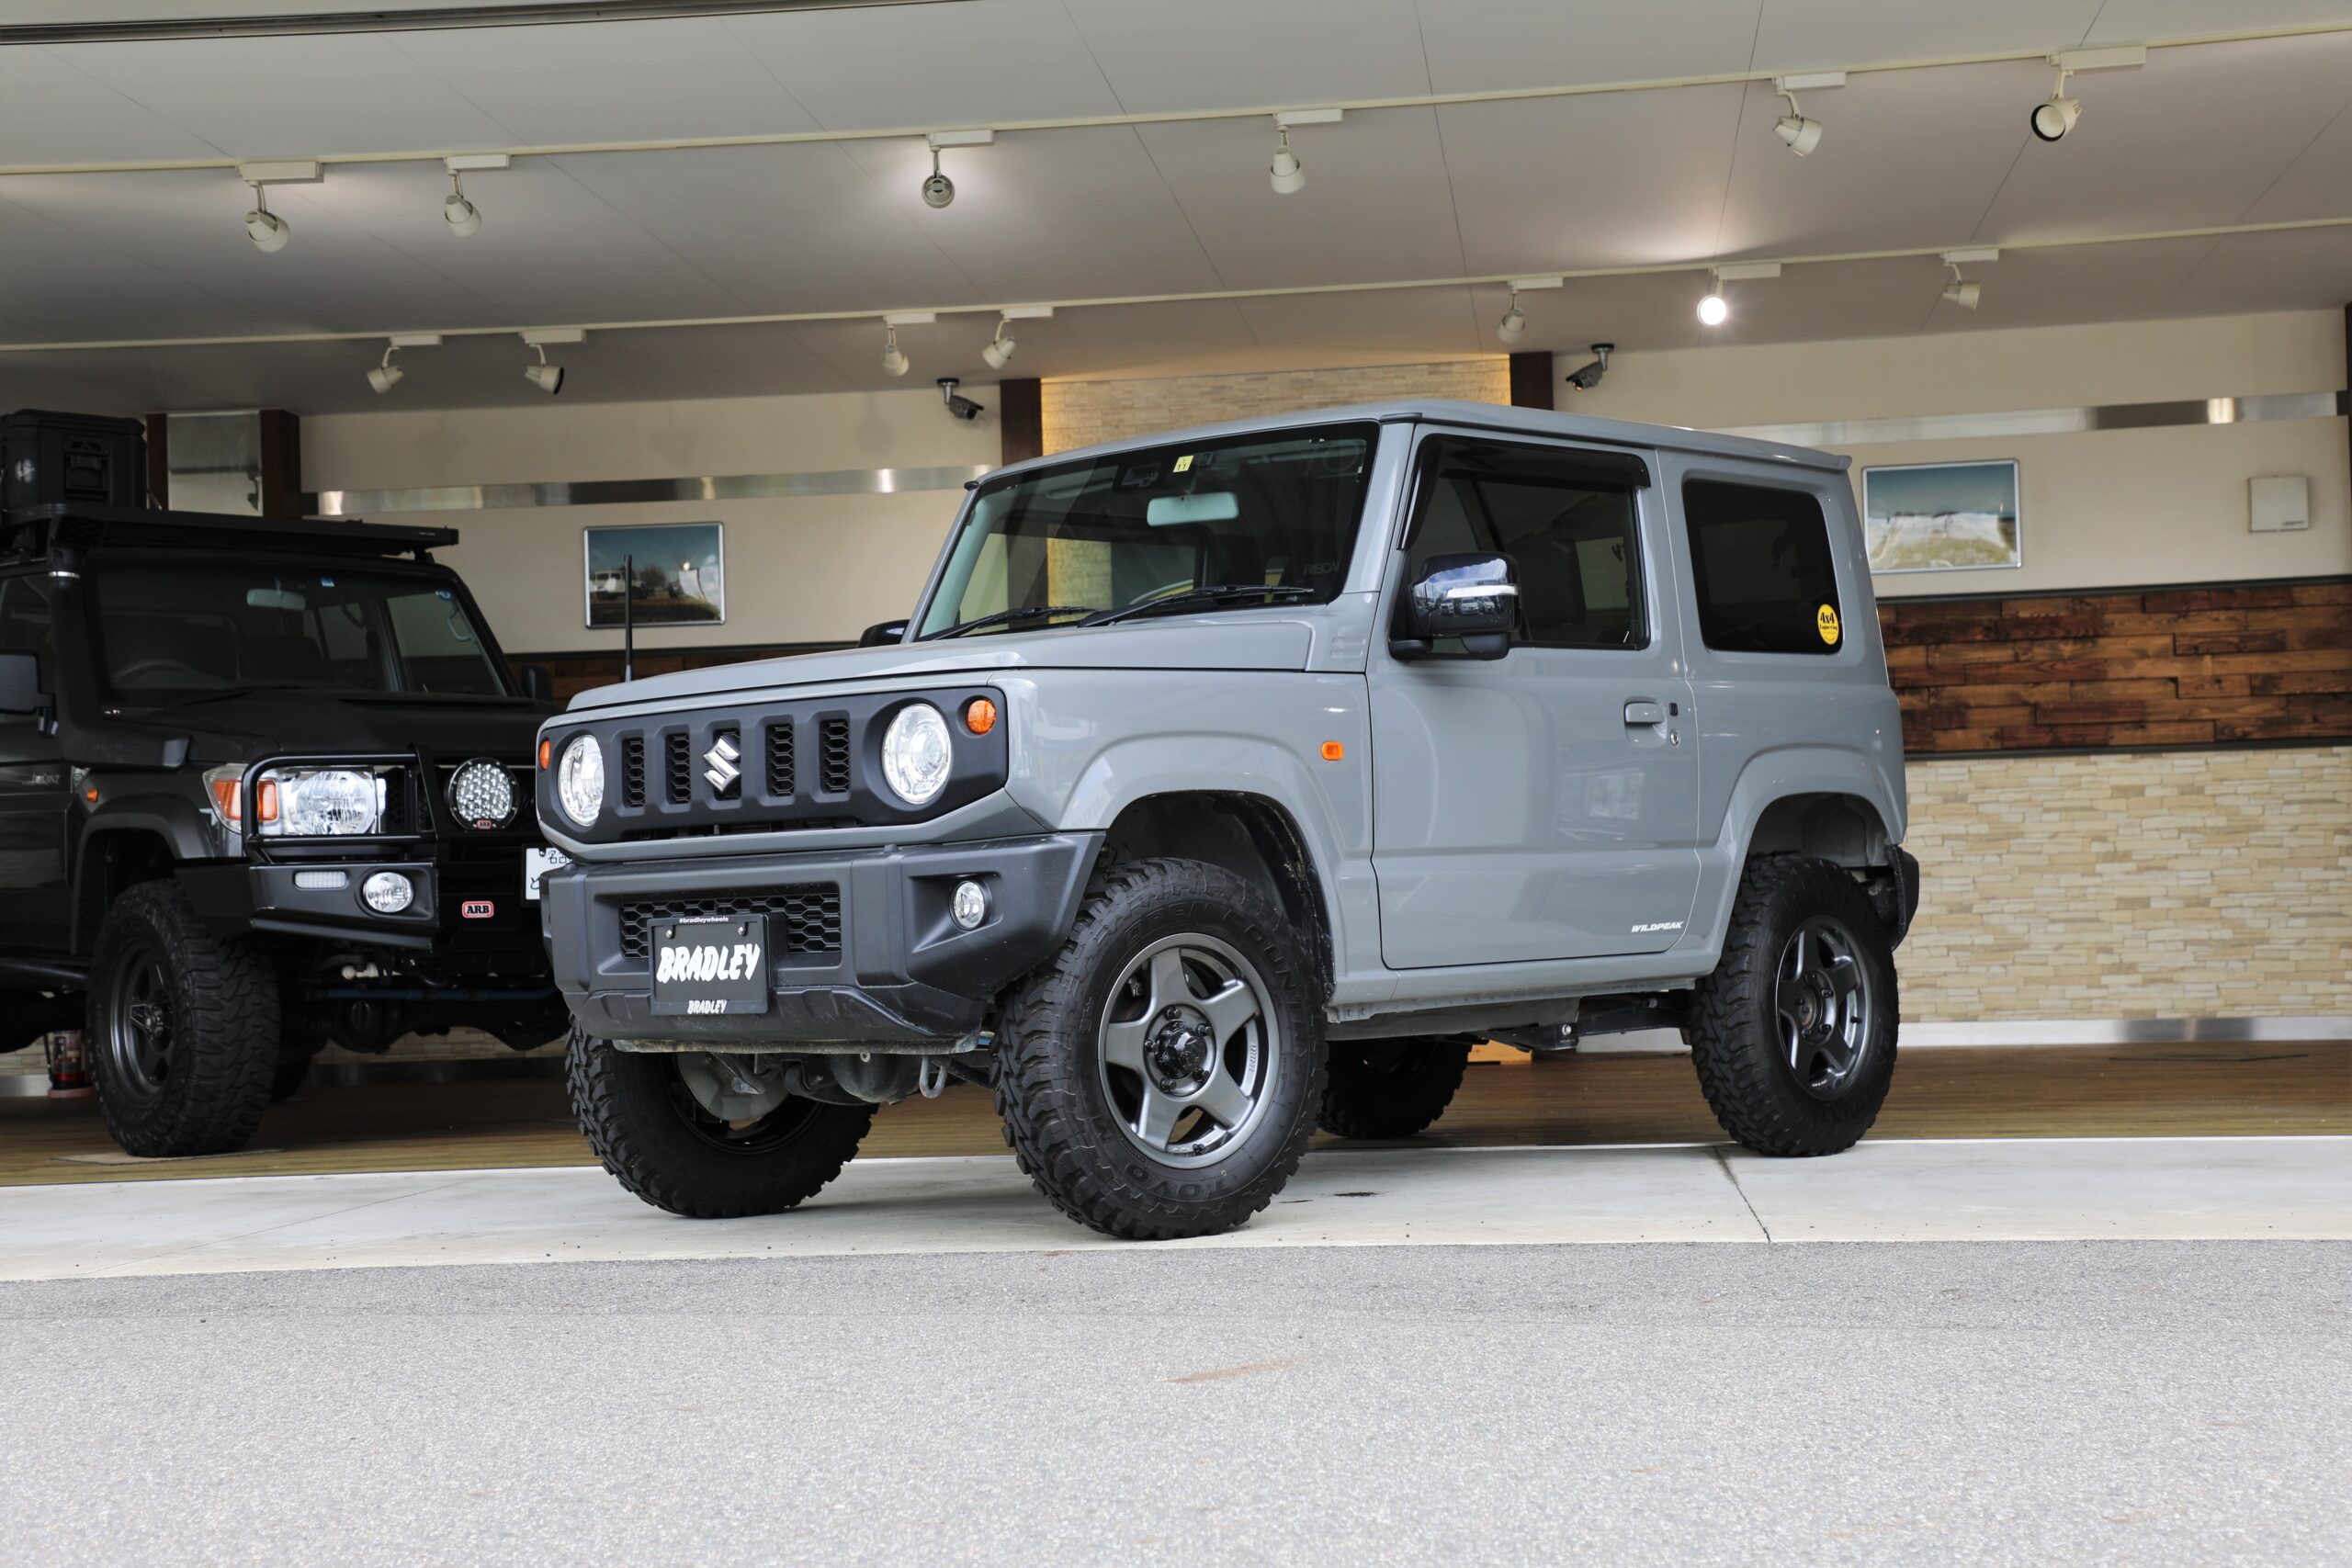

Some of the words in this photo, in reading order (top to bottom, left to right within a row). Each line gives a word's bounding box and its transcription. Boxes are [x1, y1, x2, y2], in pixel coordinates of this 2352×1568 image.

[1820, 612, 1835, 624] 4x4
[466, 905, 490, 914] ARB
[679, 916, 729, 924] #bradleywheels
[1631, 921, 1685, 933] WILDPEAK
[656, 943, 761, 984] BRADLEY
[687, 999, 727, 1014] BRADLEY
